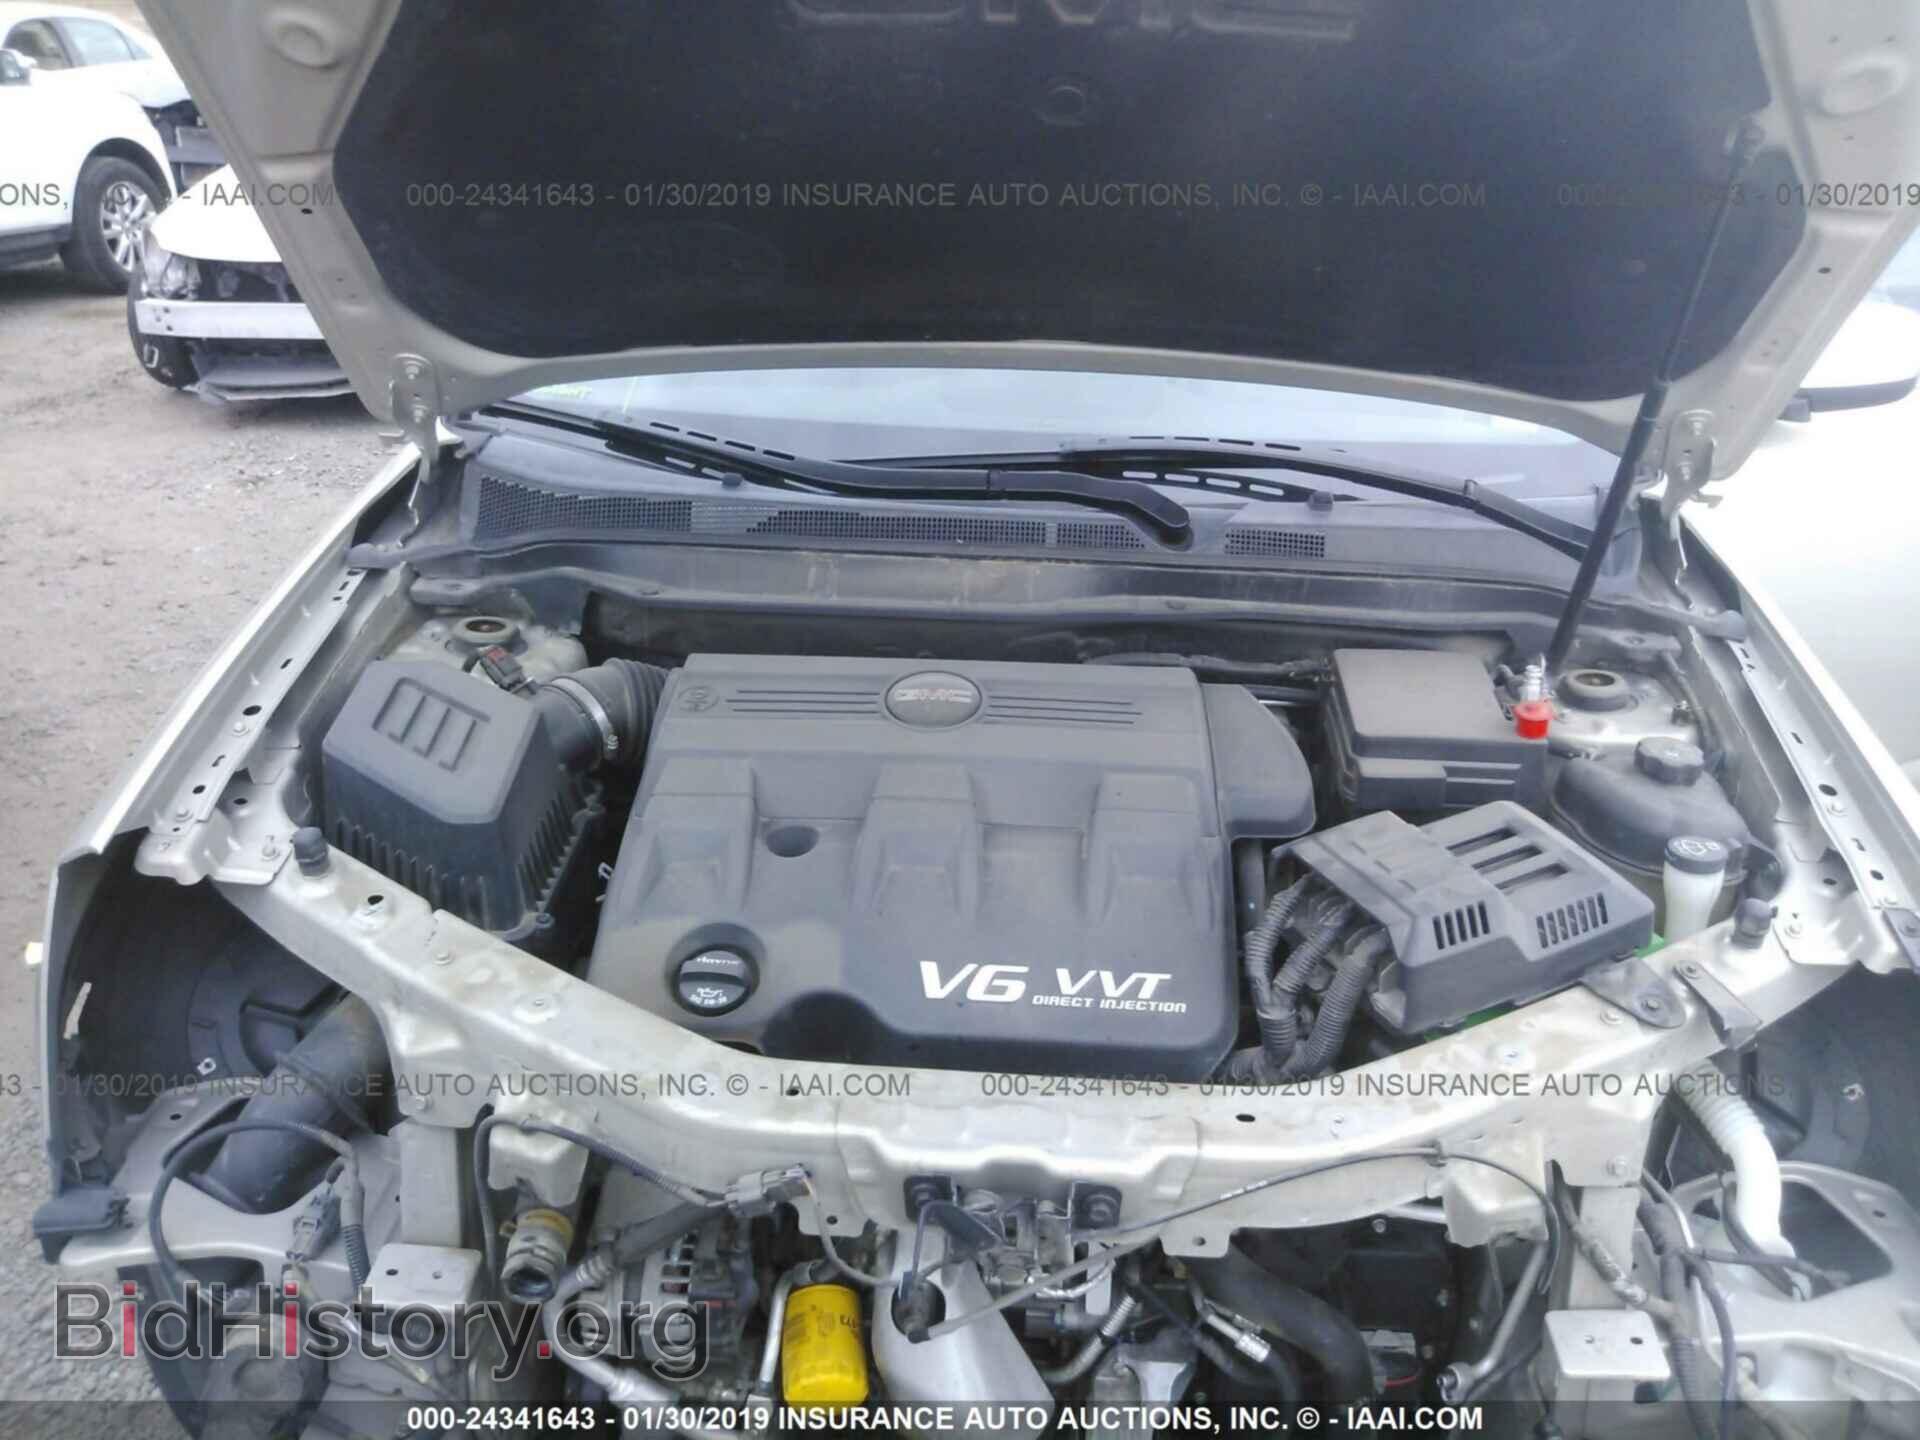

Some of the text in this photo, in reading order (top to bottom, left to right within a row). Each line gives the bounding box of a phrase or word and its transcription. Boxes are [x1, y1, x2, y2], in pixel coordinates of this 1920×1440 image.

[919, 960, 1172, 1003] V6 VVT
[1032, 994, 1186, 1013] DIRECT INJECTION
